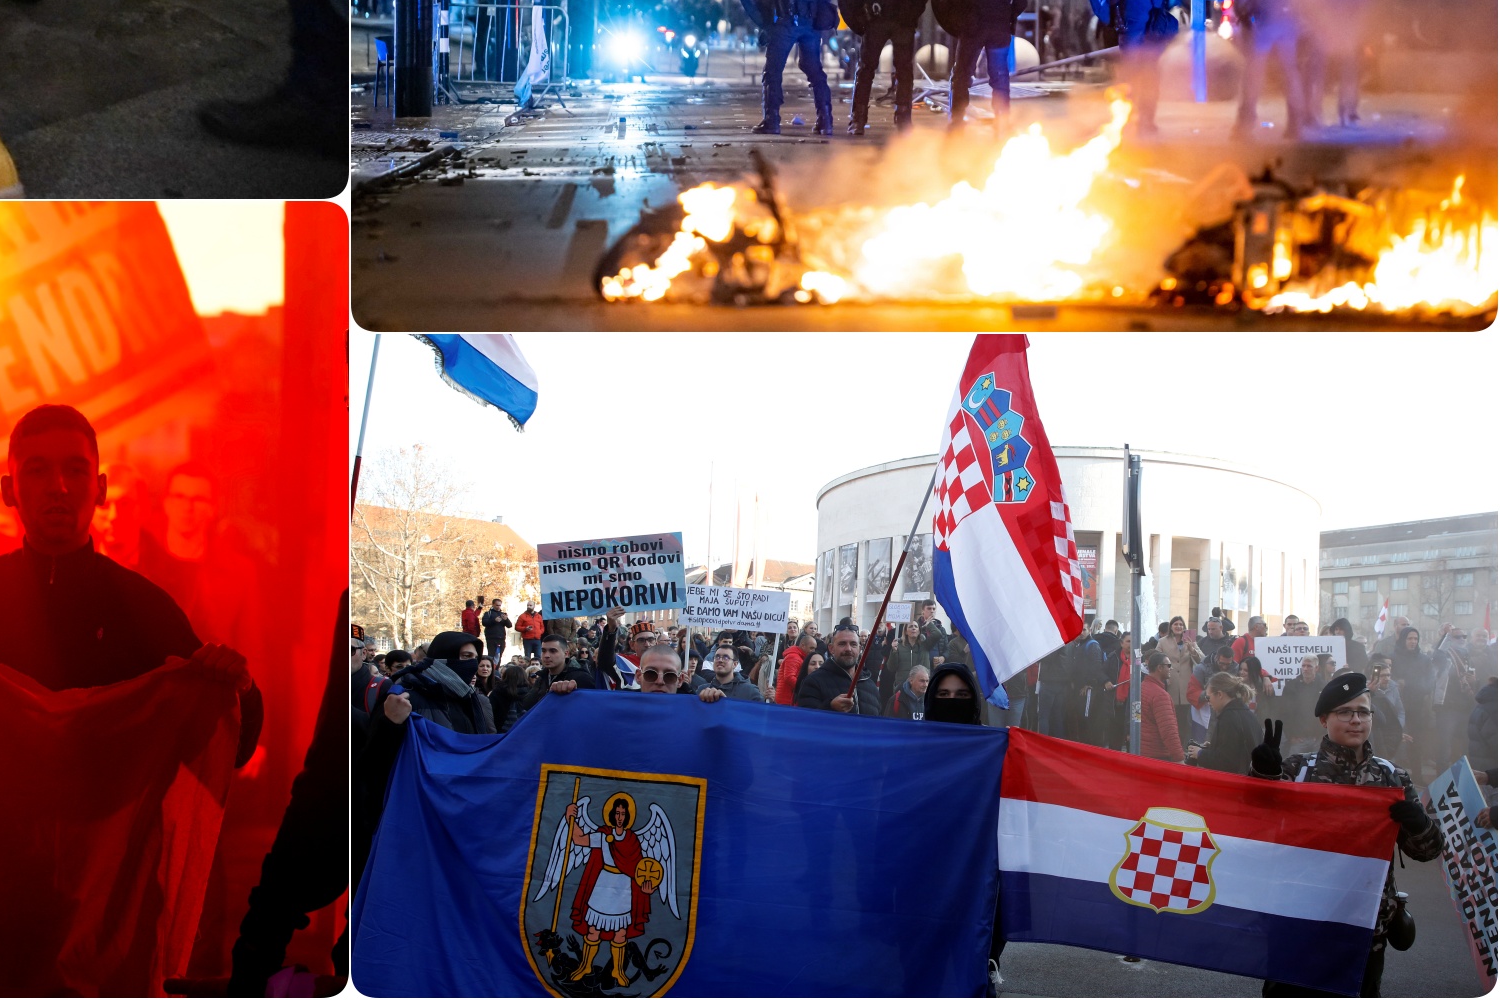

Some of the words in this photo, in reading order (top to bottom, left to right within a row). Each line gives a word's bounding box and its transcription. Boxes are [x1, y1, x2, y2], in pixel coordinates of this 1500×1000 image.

[557, 545, 607, 559] nismo
[612, 538, 664, 554] robovi
[542, 561, 592, 575] nismo
[597, 556, 621, 571] QR
[626, 551, 681, 567] kodovi
[583, 571, 603, 585] mi
[608, 571, 642, 583] smo
[549, 581, 678, 613] NEPOKORIVI
[699, 596, 719, 605] MAJA
[709, 588, 719, 596] MI
[723, 589, 733, 598] SE
[736, 591, 750, 601] ŠTO
[752, 594, 769, 603] RADI
[682, 606, 695, 615] NE
[697, 607, 721, 617] DAMO
[723, 608, 739, 618] VAM
[741, 610, 763, 620] NAŠU
[1267, 644, 1291, 654] NAŠI
[1293, 645, 1333, 654] TEMELJI
[1279, 657, 1292, 665] SU
[1437, 793, 1498, 962] ENERACIJA
